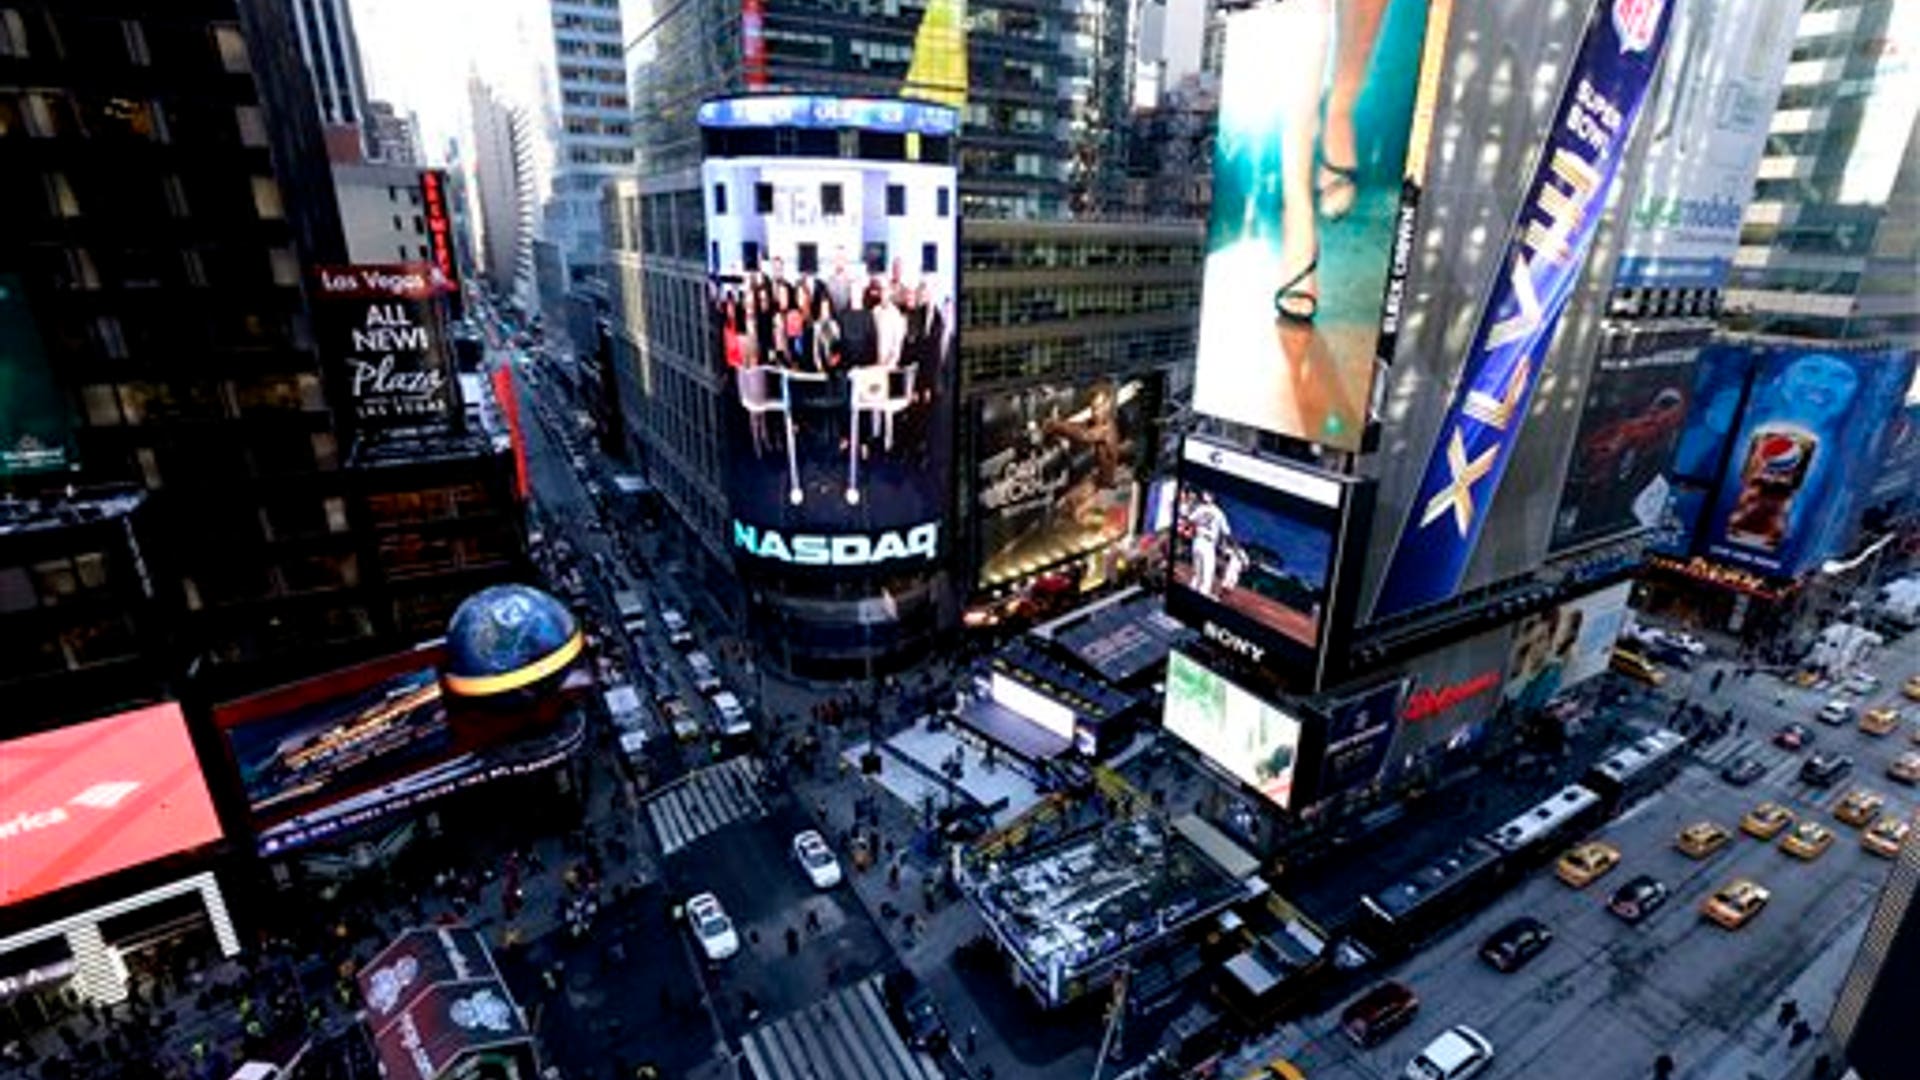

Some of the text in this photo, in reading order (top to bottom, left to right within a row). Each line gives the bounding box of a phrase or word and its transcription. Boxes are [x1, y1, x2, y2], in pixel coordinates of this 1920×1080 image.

[321, 269, 426, 295] Las Vegas
[366, 304, 412, 327] ALL
[734, 518, 941, 566] NASDAQ
[1202, 620, 1265, 663] SONY
